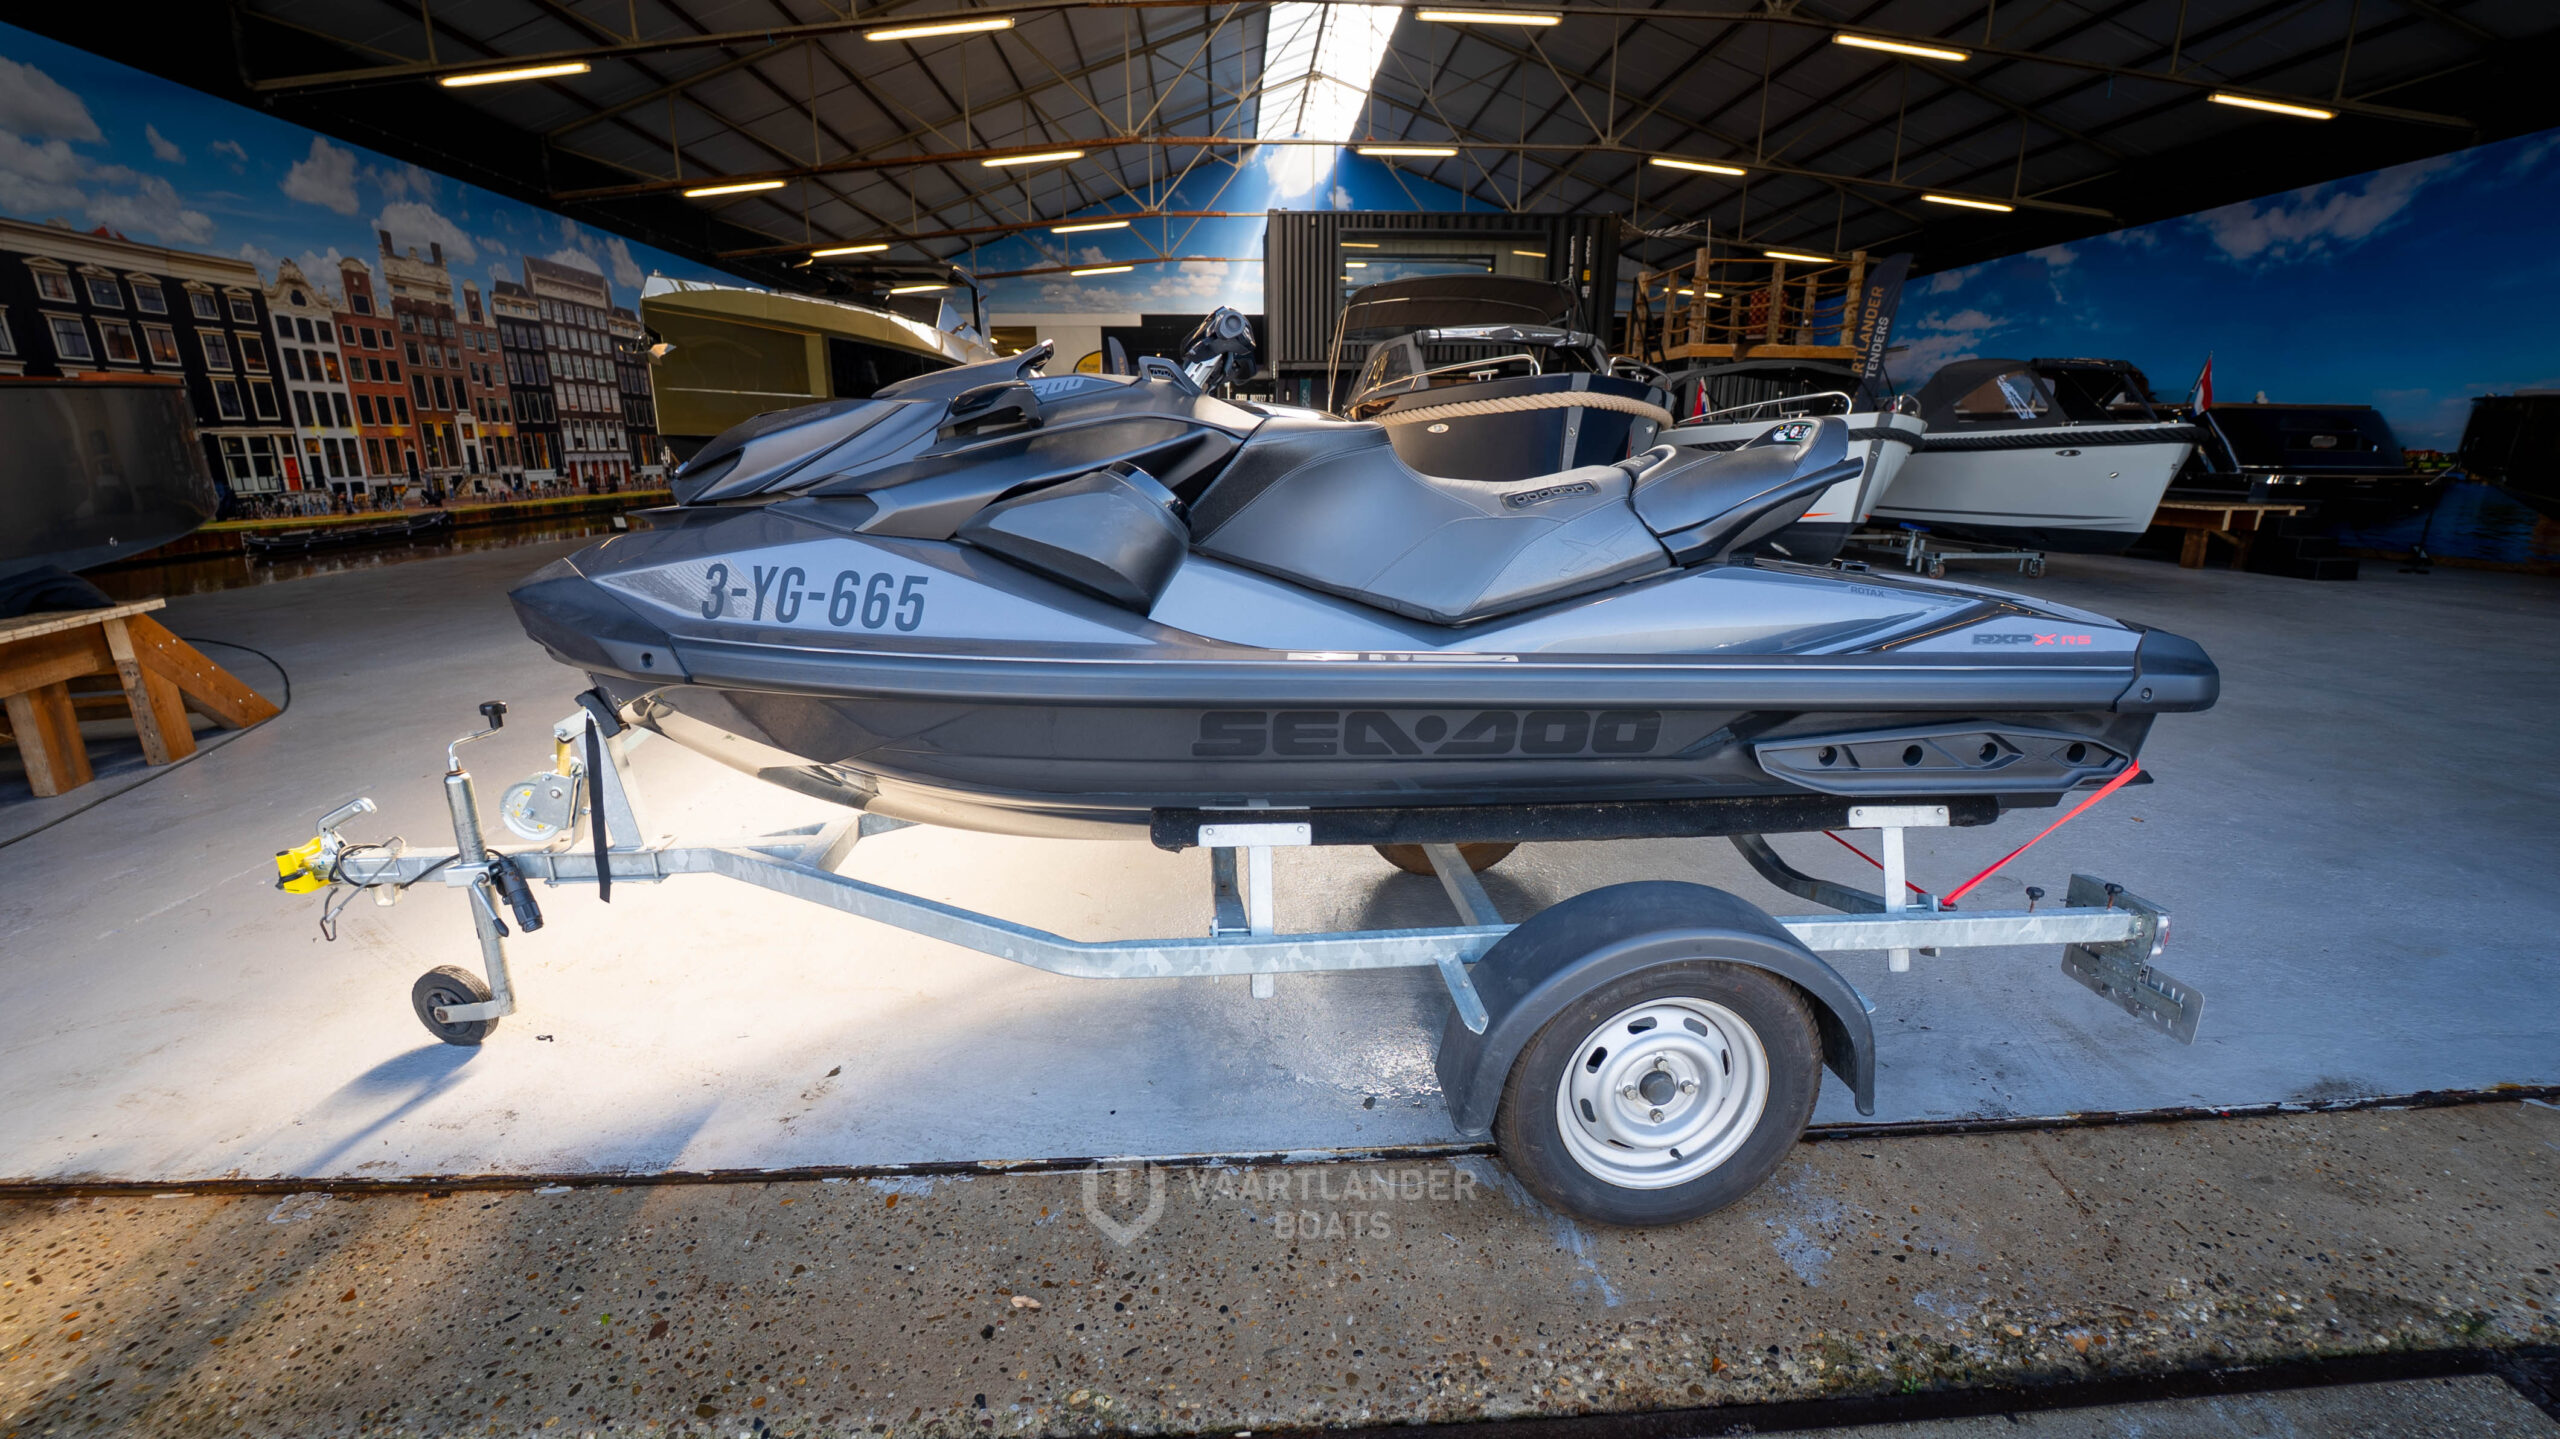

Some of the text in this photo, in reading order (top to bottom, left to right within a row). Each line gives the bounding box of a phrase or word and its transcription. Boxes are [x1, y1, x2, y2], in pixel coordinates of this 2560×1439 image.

[1851, 285, 1885, 375] RTLANDER
[1865, 316, 1890, 379] TENDERS
[1034, 378, 1085, 396] 300
[701, 563, 929, 632] 3-YG-665
[1850, 585, 1886, 598] ROTAX
[2060, 635, 2092, 645] RS
